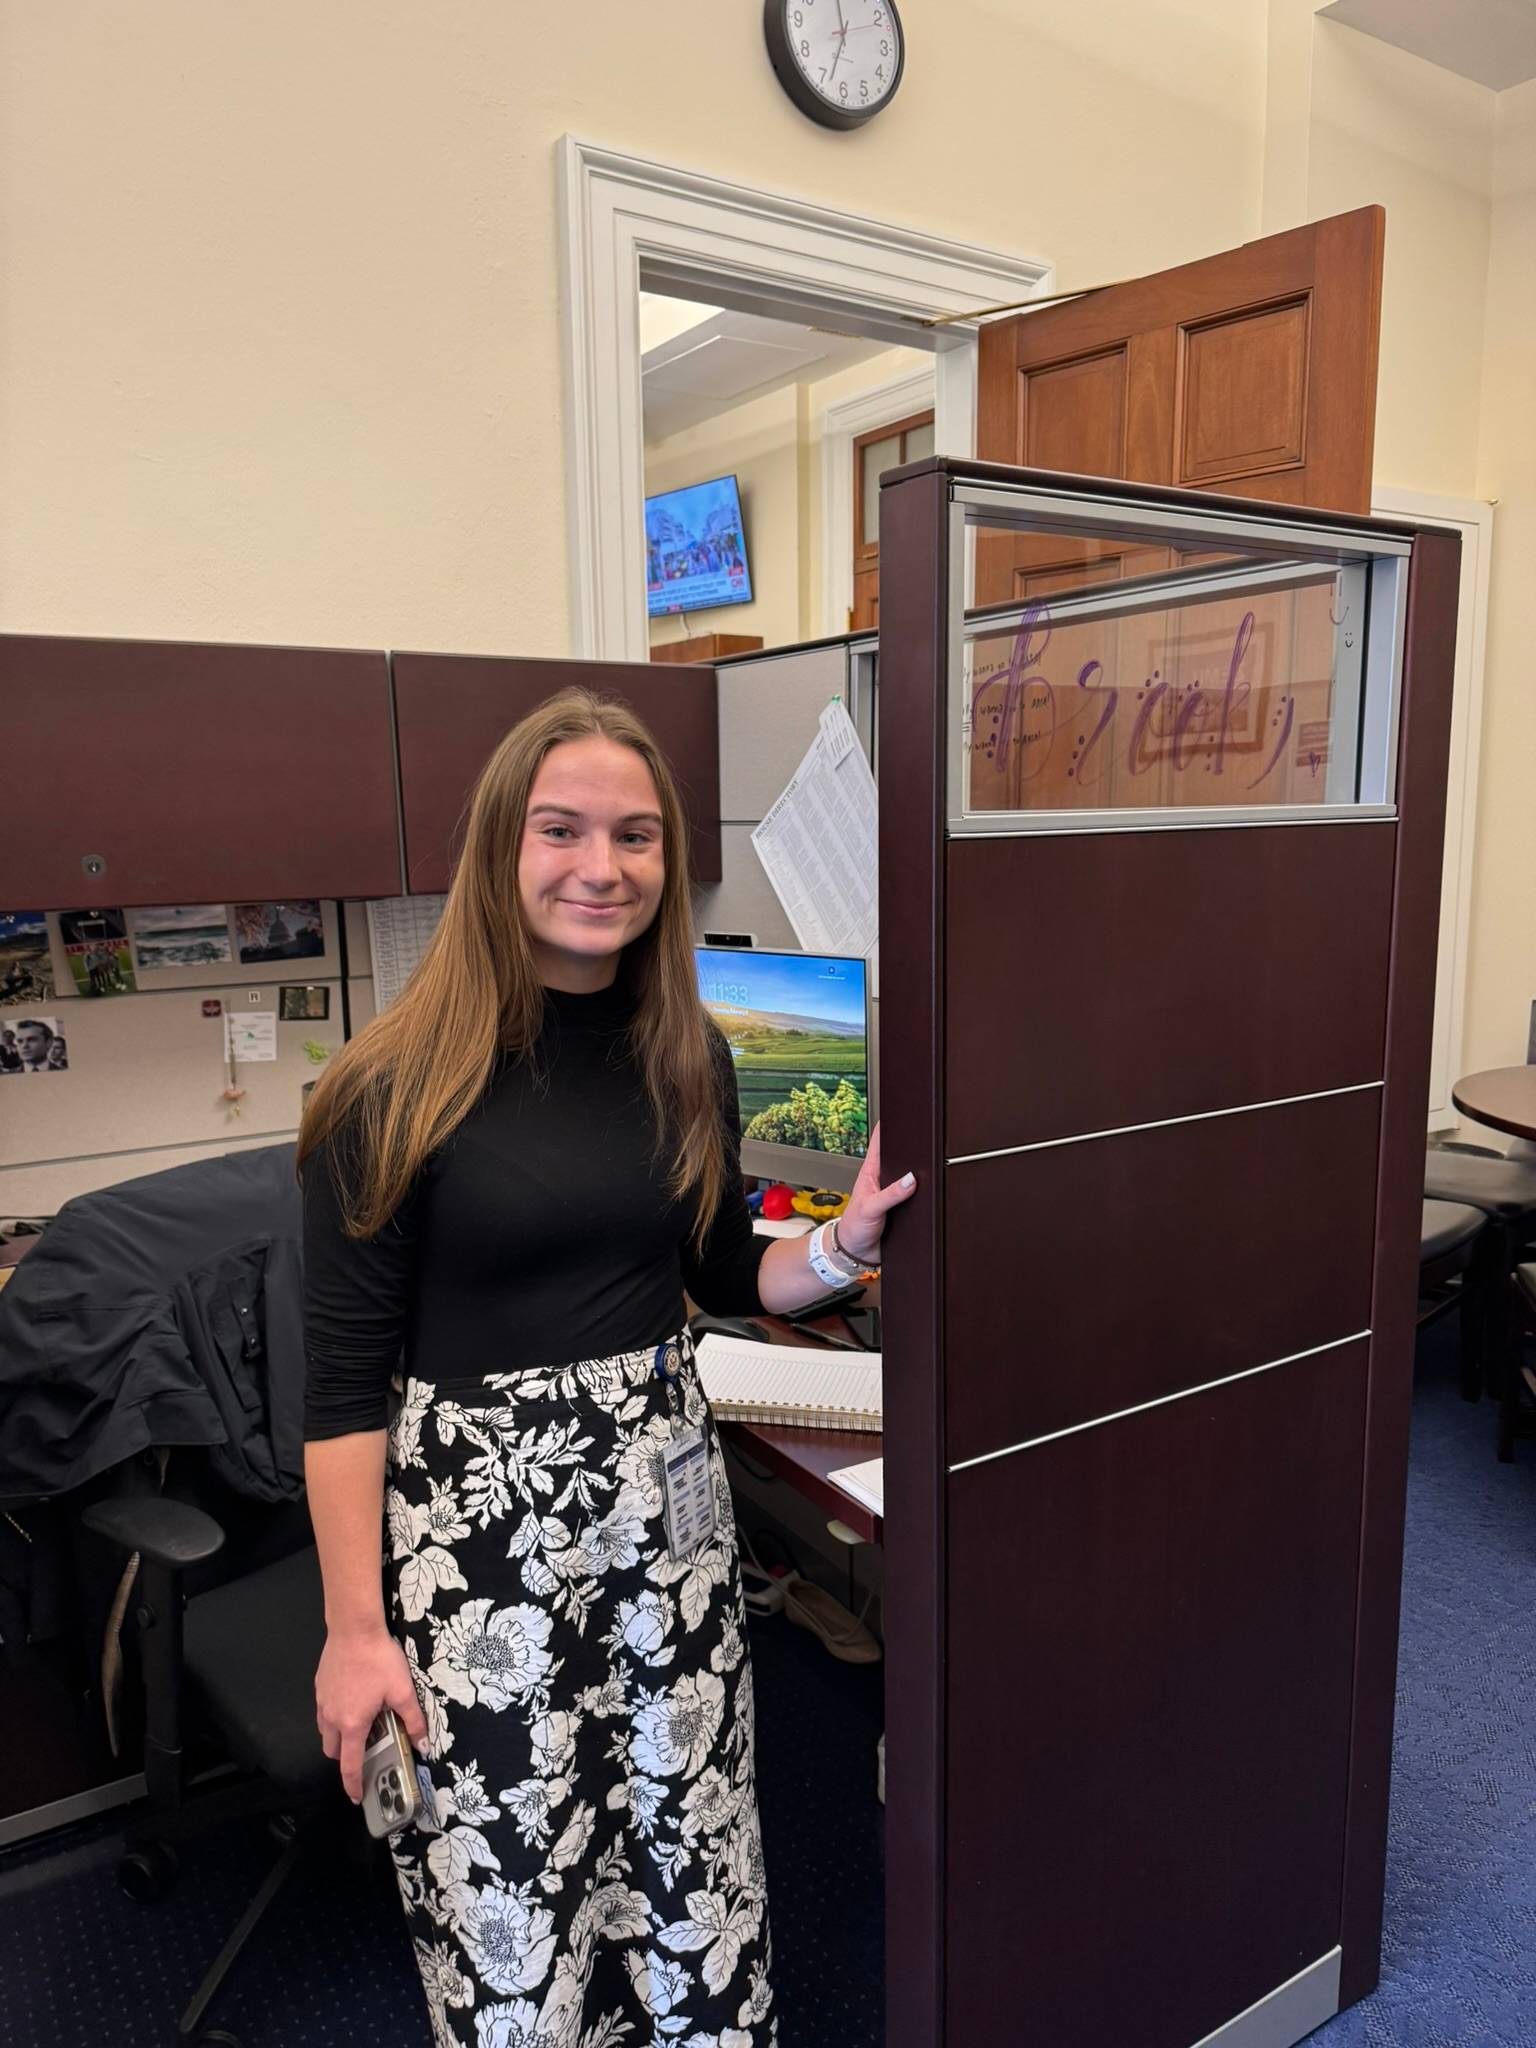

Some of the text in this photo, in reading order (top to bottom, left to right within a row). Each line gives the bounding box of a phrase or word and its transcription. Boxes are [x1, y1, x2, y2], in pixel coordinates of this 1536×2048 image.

[793, 10, 804, 28] 9
[873, 9, 883, 28] 2
[800, 39, 810, 58] 8
[880, 39, 889, 57] 3
[818, 66, 828, 84] 7
[874, 63, 884, 80] 4
[839, 81, 849, 99] 6
[859, 80, 869, 97] 5
